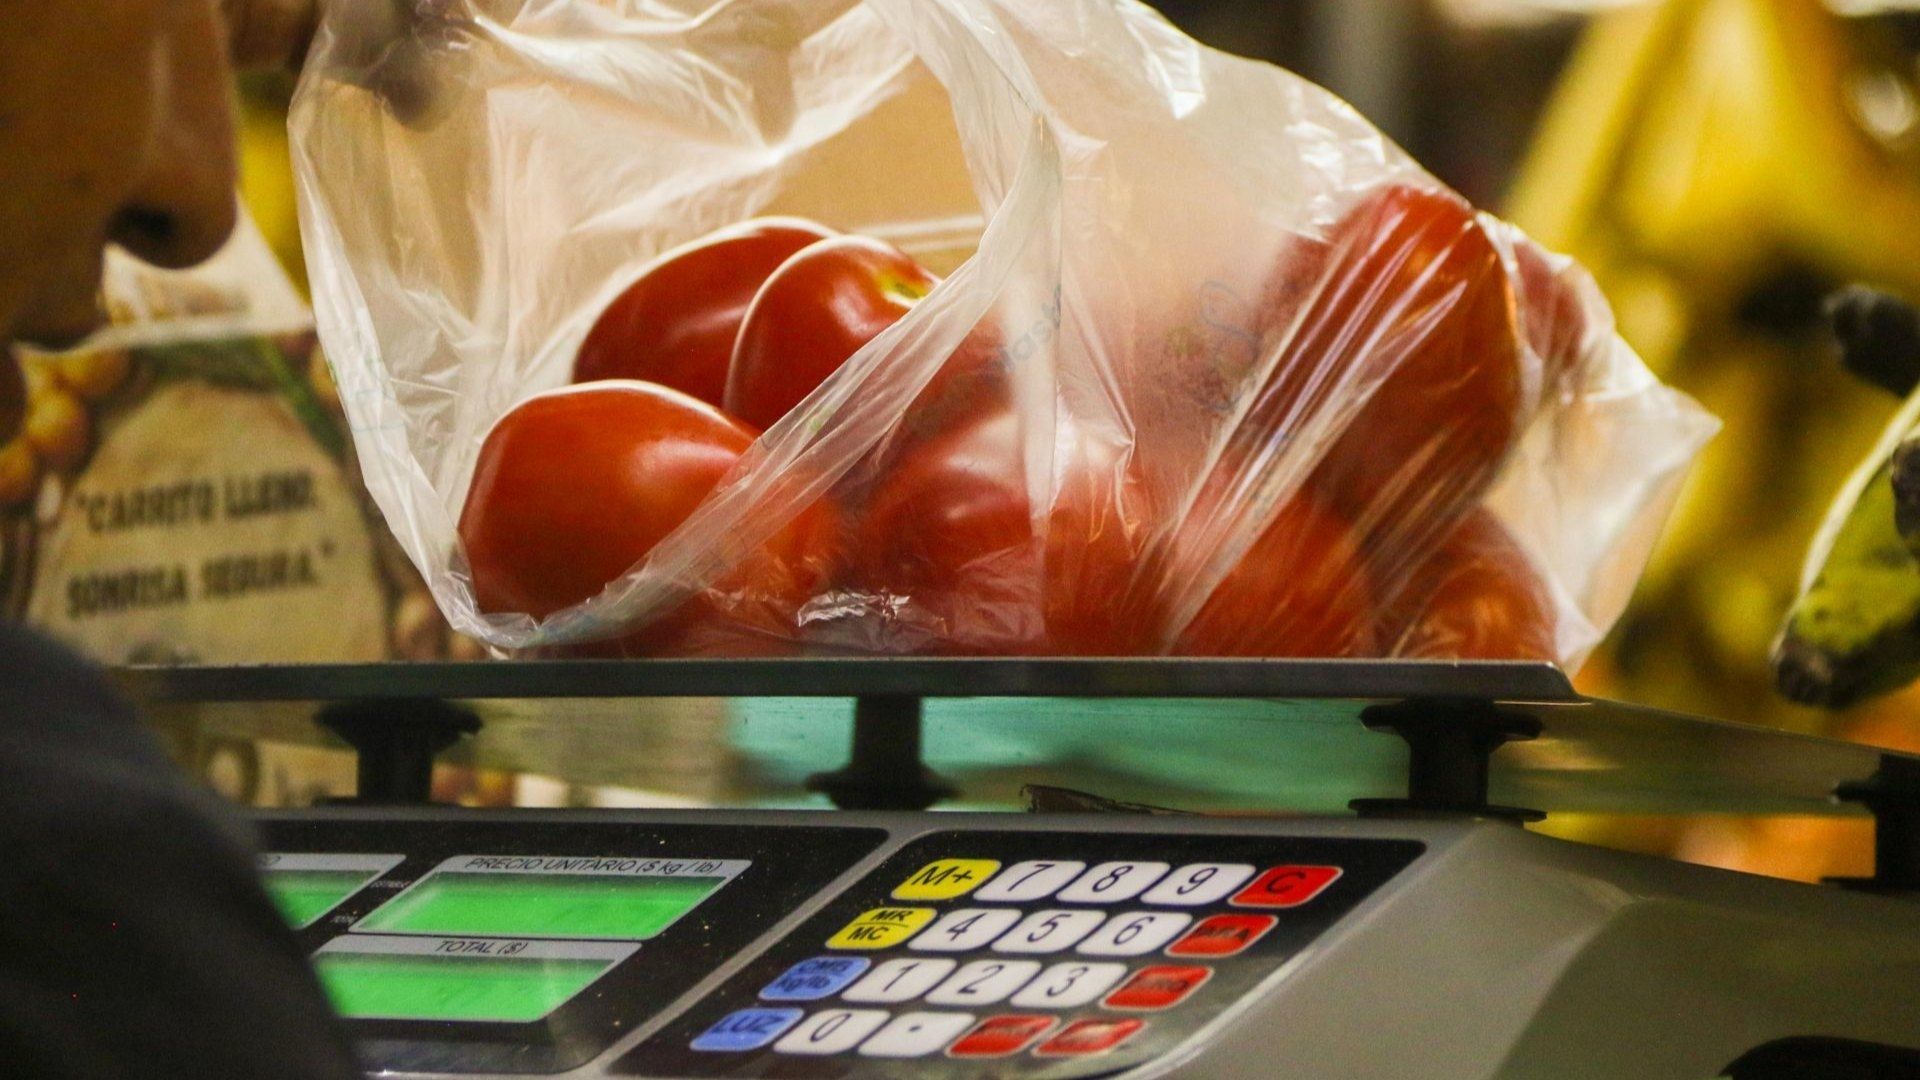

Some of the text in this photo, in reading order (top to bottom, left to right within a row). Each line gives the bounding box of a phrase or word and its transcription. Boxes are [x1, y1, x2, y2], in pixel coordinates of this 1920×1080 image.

[465, 858, 542, 870] PRECIO
[543, 859, 637, 871] UNITARIO
[911, 864, 1308, 895] M+ 7 8 9 C
[847, 926, 890, 941] MC
[946, 912, 987, 942] 4
[1026, 913, 1072, 942] 5
[1112, 915, 1156, 945] 6
[871, 909, 914, 922] MR
[435, 940, 528, 955] TOTAL ($)
[883, 963, 920, 992] 1
[956, 964, 1005, 995] 2
[1045, 966, 1090, 998] 3
[809, 1013, 853, 1043] 0
